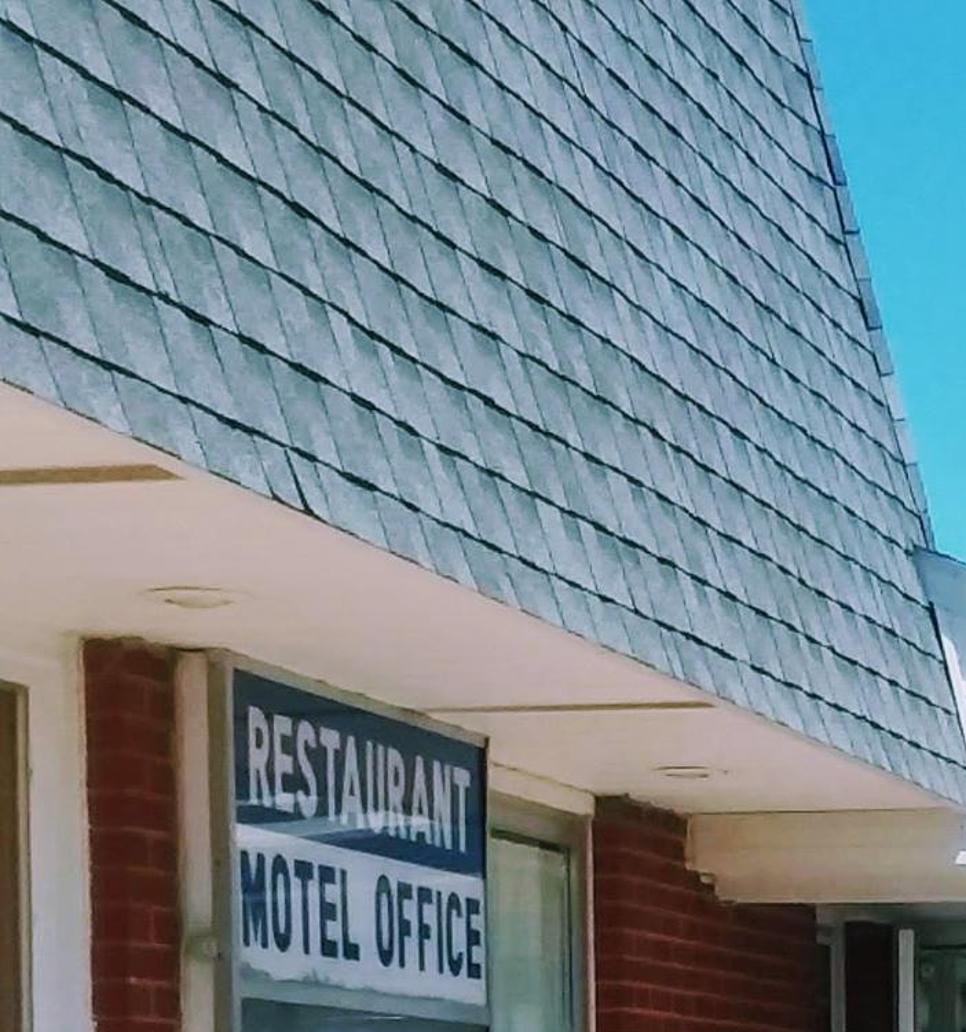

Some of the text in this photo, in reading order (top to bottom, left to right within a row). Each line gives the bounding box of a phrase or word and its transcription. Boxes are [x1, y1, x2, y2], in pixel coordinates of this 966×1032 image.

[247, 706, 471, 852] RESTAURANT
[240, 850, 482, 979] MOTEL OFFICE
